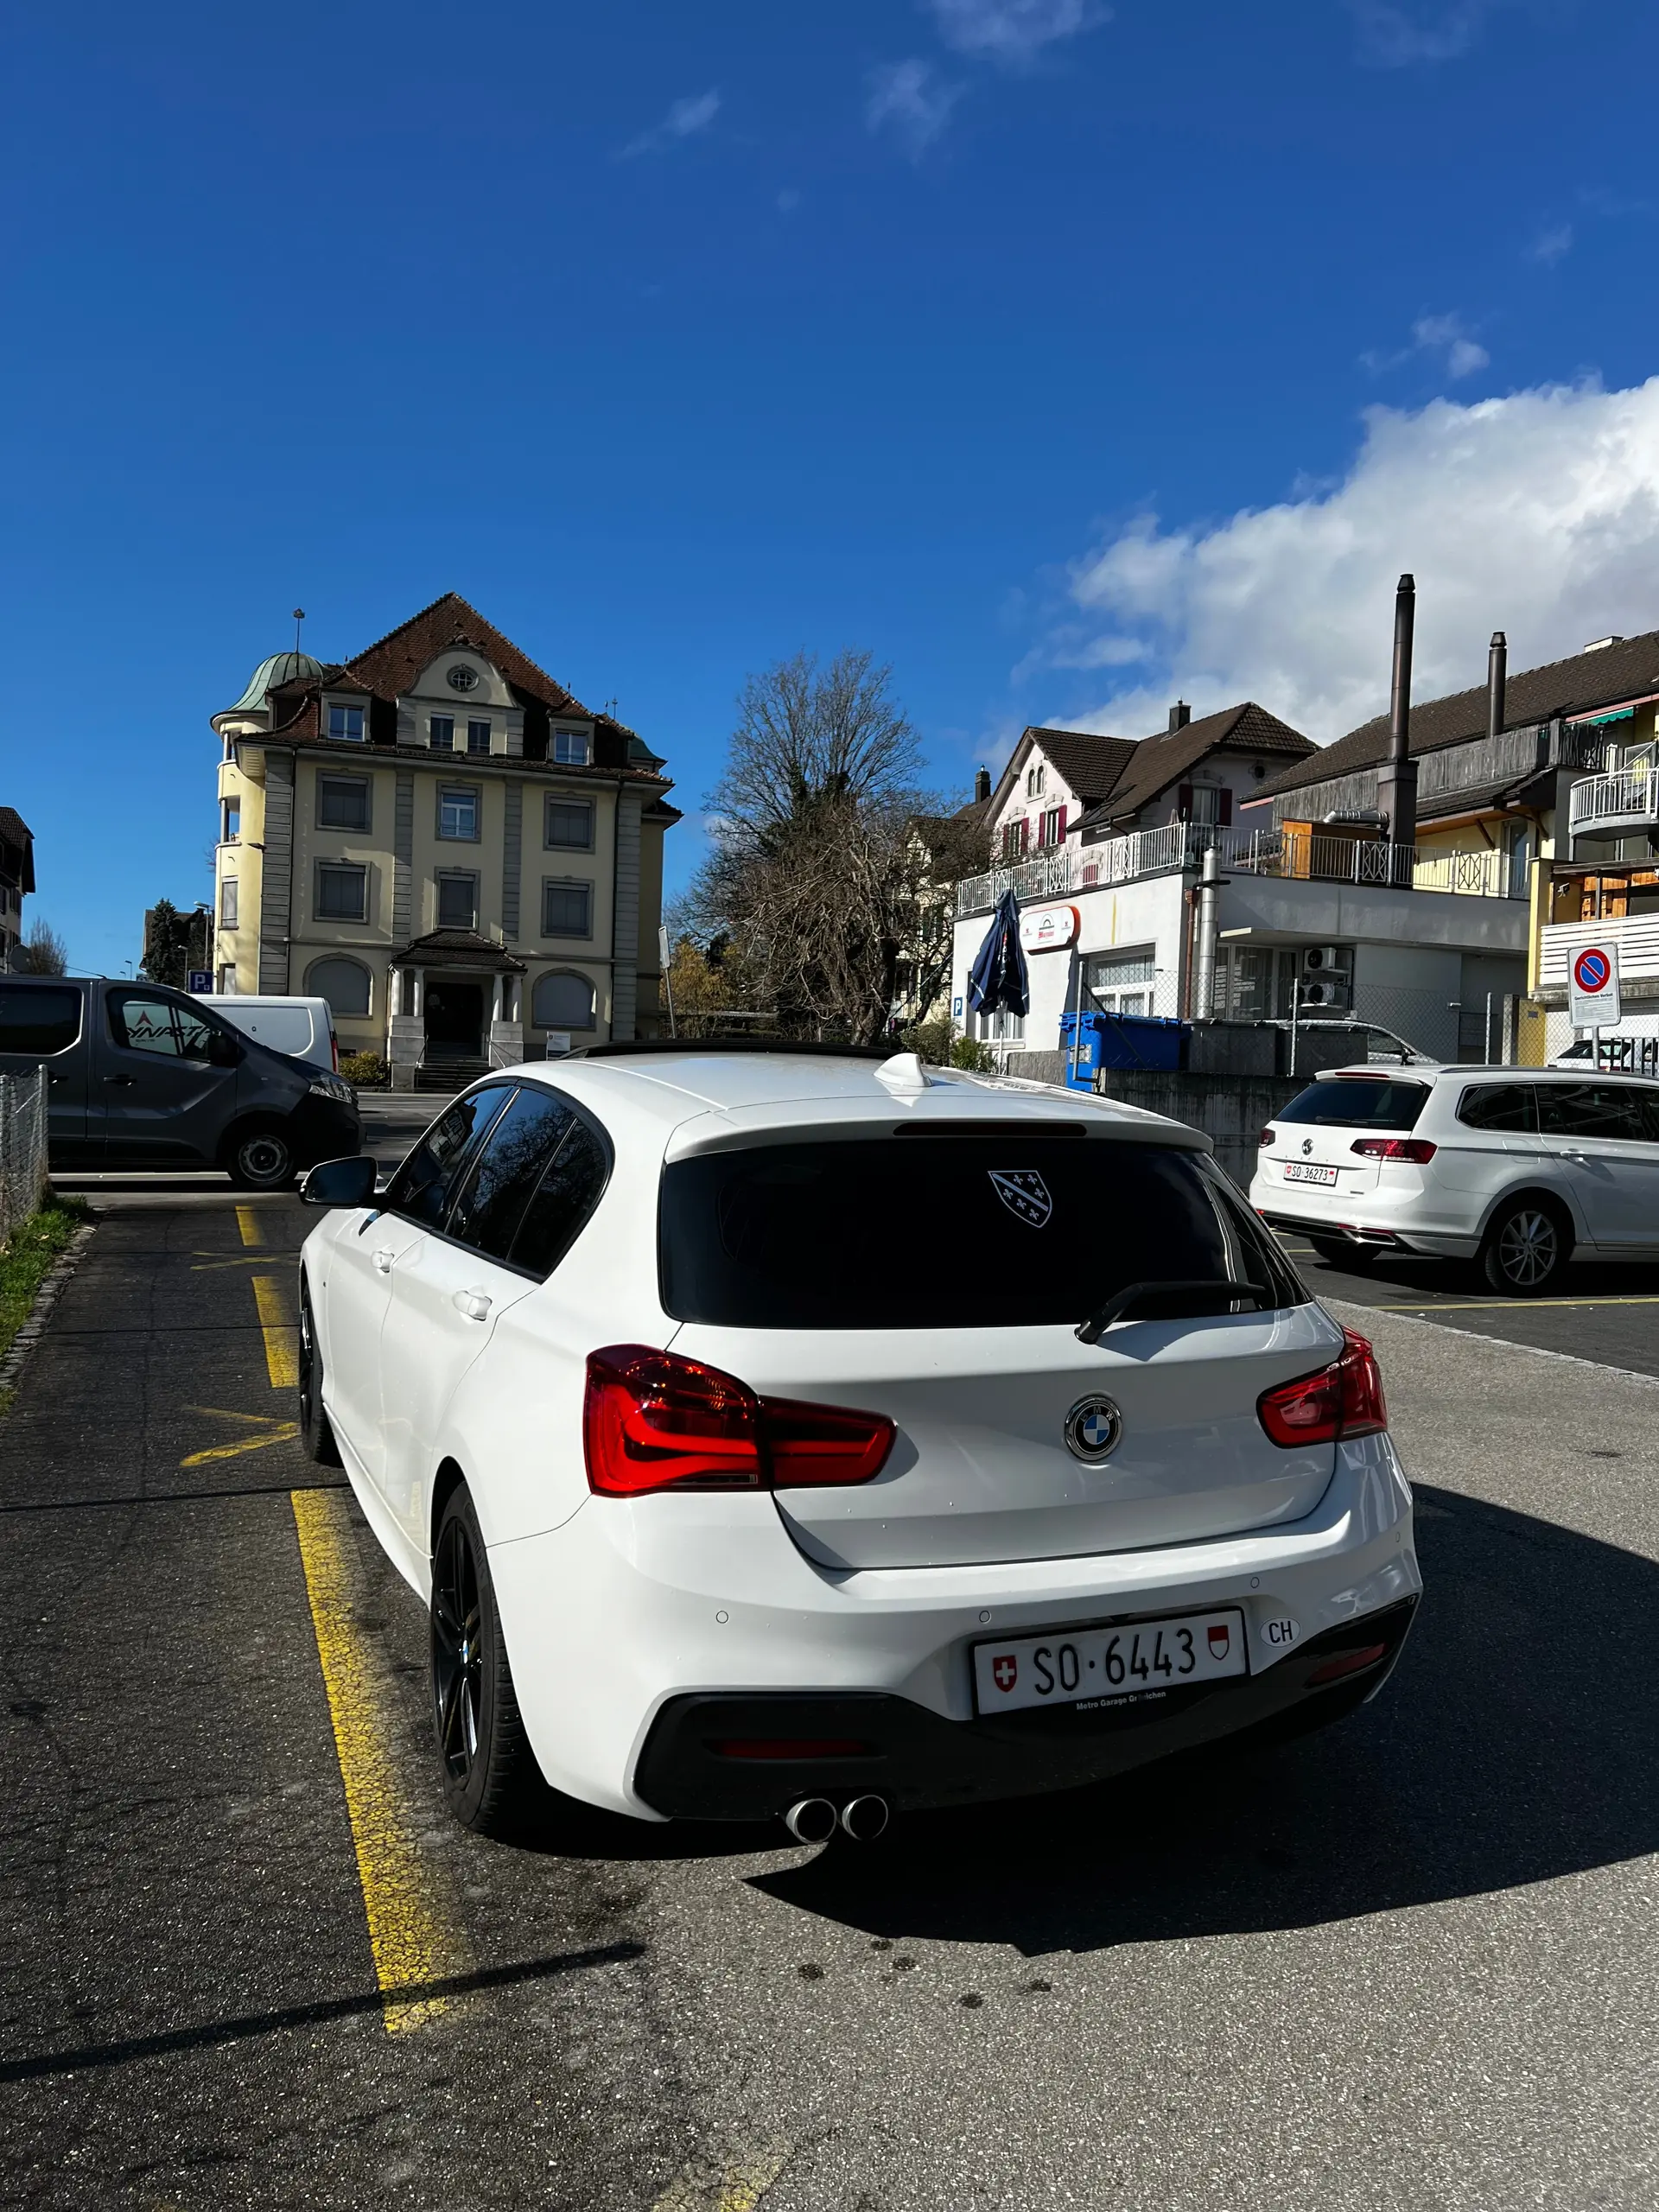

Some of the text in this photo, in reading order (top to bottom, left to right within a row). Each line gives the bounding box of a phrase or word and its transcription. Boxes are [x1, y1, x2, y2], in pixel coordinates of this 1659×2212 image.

[195, 975, 205, 989] P
[956, 999, 962, 1014] P
[1080, 1406, 1114, 1422] BMW
[1268, 1620, 1293, 1643] CH
[1076, 1701, 1099, 1711] Metro
[1100, 1697, 1128, 1707] Garage
